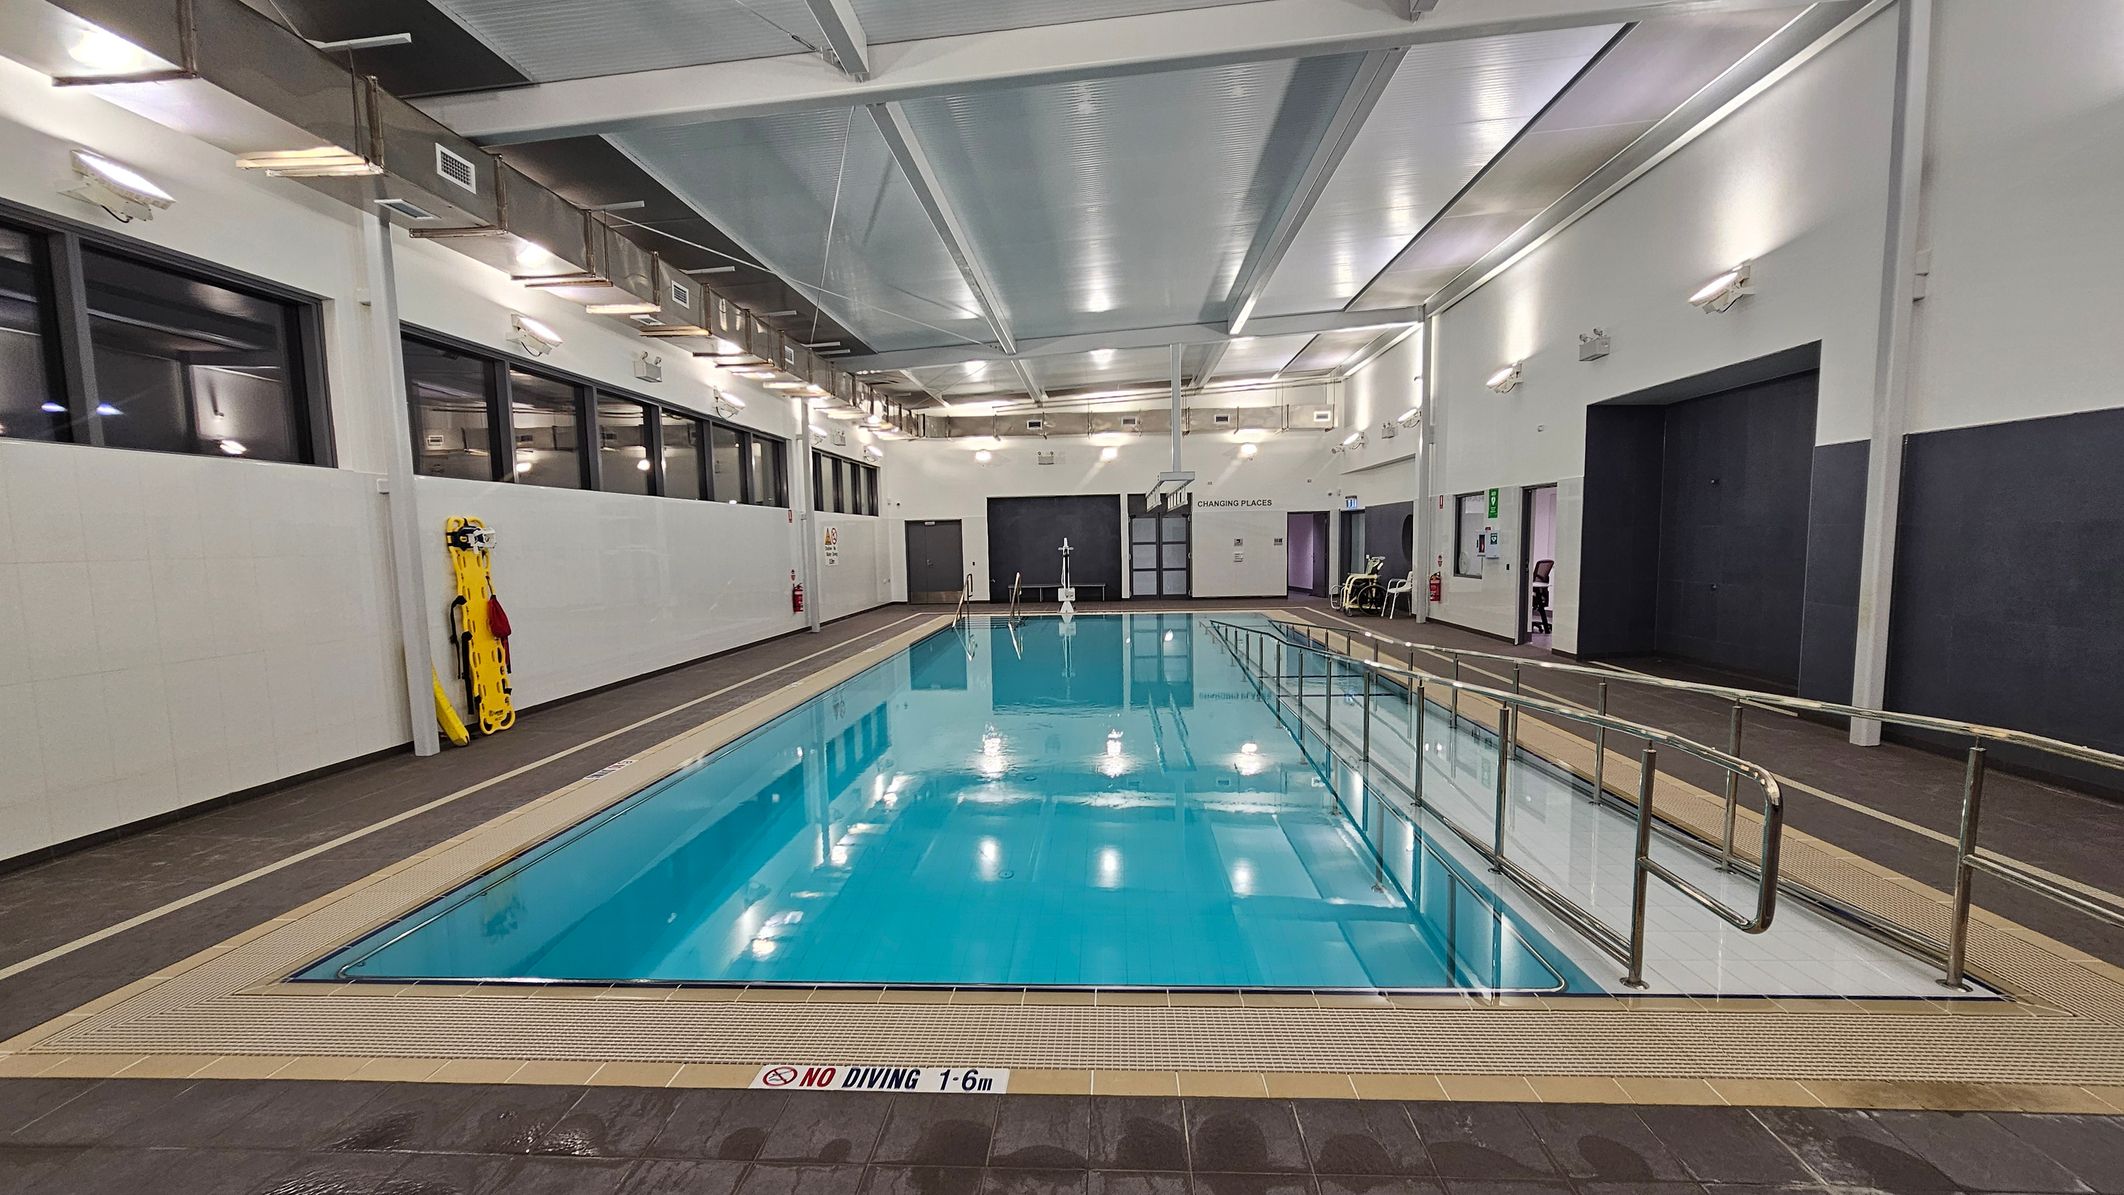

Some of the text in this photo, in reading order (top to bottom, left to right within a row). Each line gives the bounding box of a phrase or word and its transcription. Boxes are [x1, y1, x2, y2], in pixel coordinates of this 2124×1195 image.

[1240, 499, 1272, 507] PLACES
[799, 1067, 837, 1087] NO
[841, 1068, 921, 1089] DIVING
